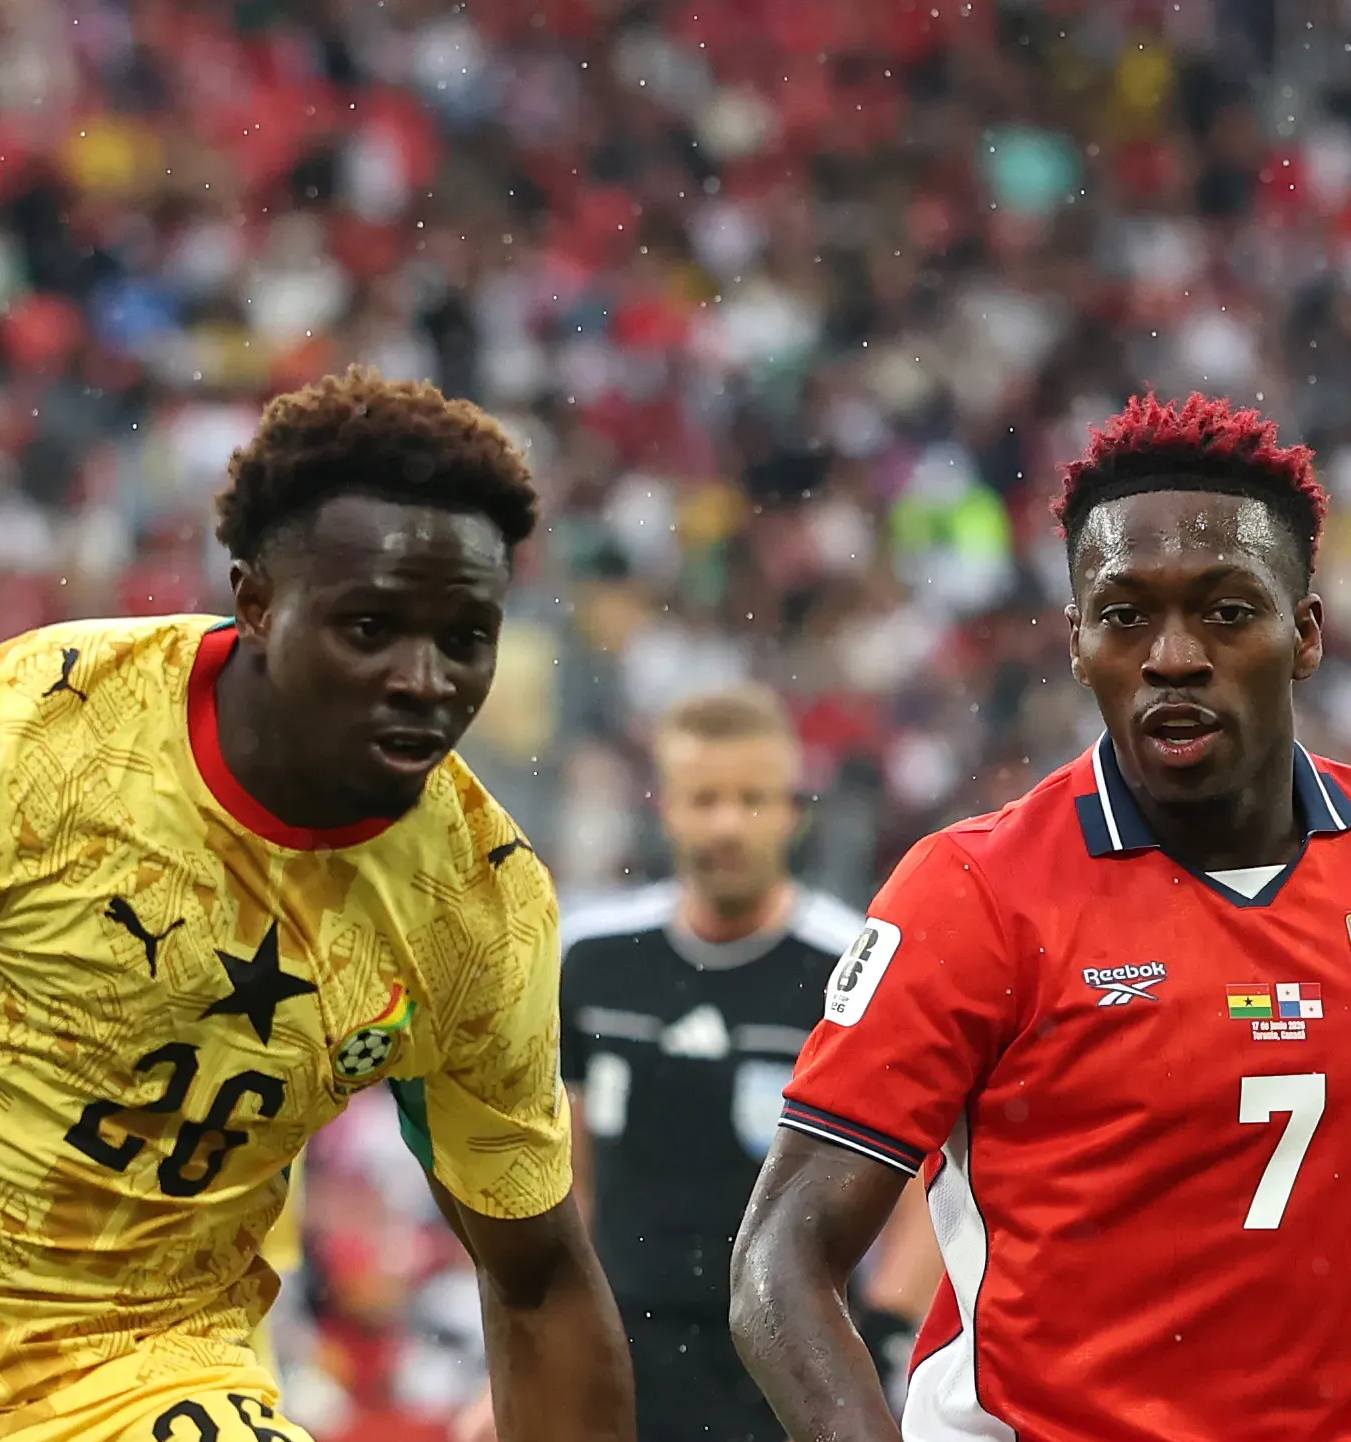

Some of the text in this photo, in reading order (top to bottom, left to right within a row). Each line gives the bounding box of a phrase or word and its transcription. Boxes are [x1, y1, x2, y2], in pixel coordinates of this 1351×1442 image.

[1083, 961, 1166, 985] Reebok
[64, 1041, 287, 1197] 26
[1239, 1073, 1327, 1229] 7
